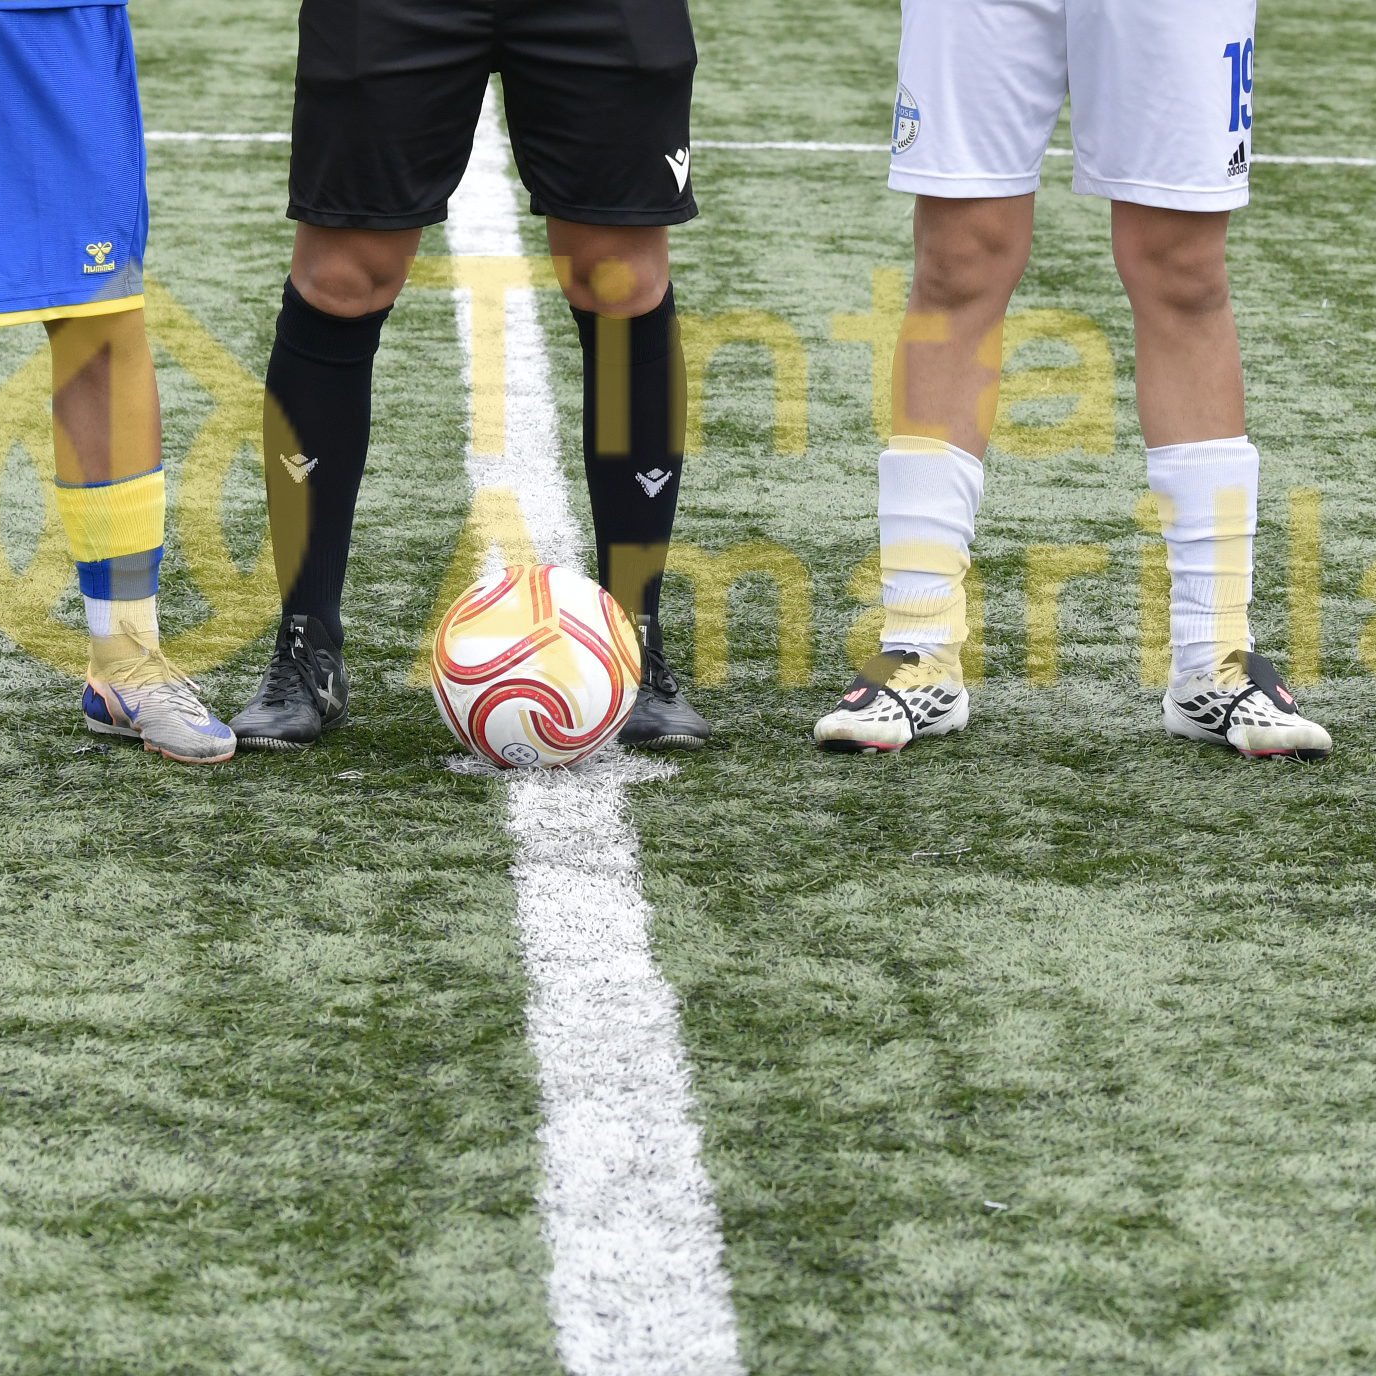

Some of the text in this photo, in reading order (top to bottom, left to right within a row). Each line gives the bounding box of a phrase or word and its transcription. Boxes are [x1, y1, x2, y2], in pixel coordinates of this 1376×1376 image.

[1223, 37, 1253, 133] 19
[1227, 161, 1248, 177] adidas
[83, 260, 115, 274] hummel
